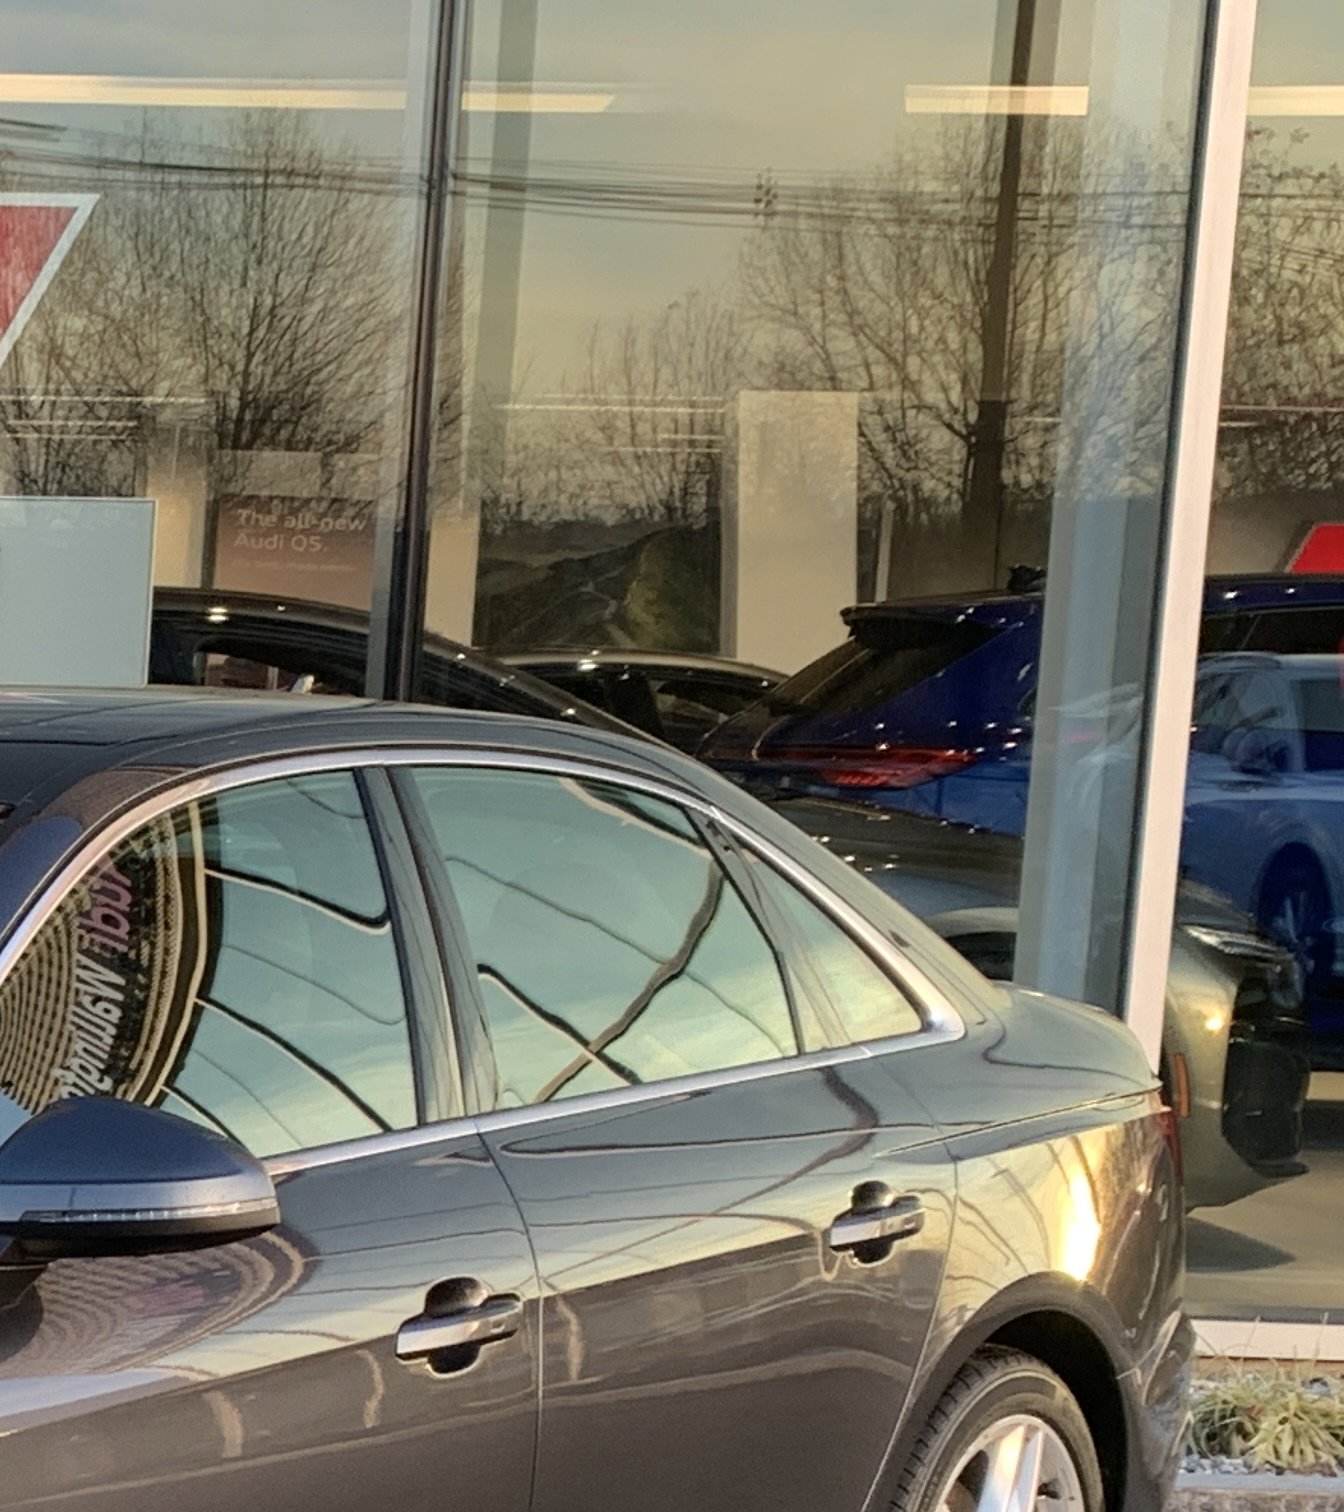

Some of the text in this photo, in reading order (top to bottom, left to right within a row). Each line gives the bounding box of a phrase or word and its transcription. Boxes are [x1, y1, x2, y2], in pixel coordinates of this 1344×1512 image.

[236, 508, 368, 532] The all-new
[233, 532, 283, 550] Audi
